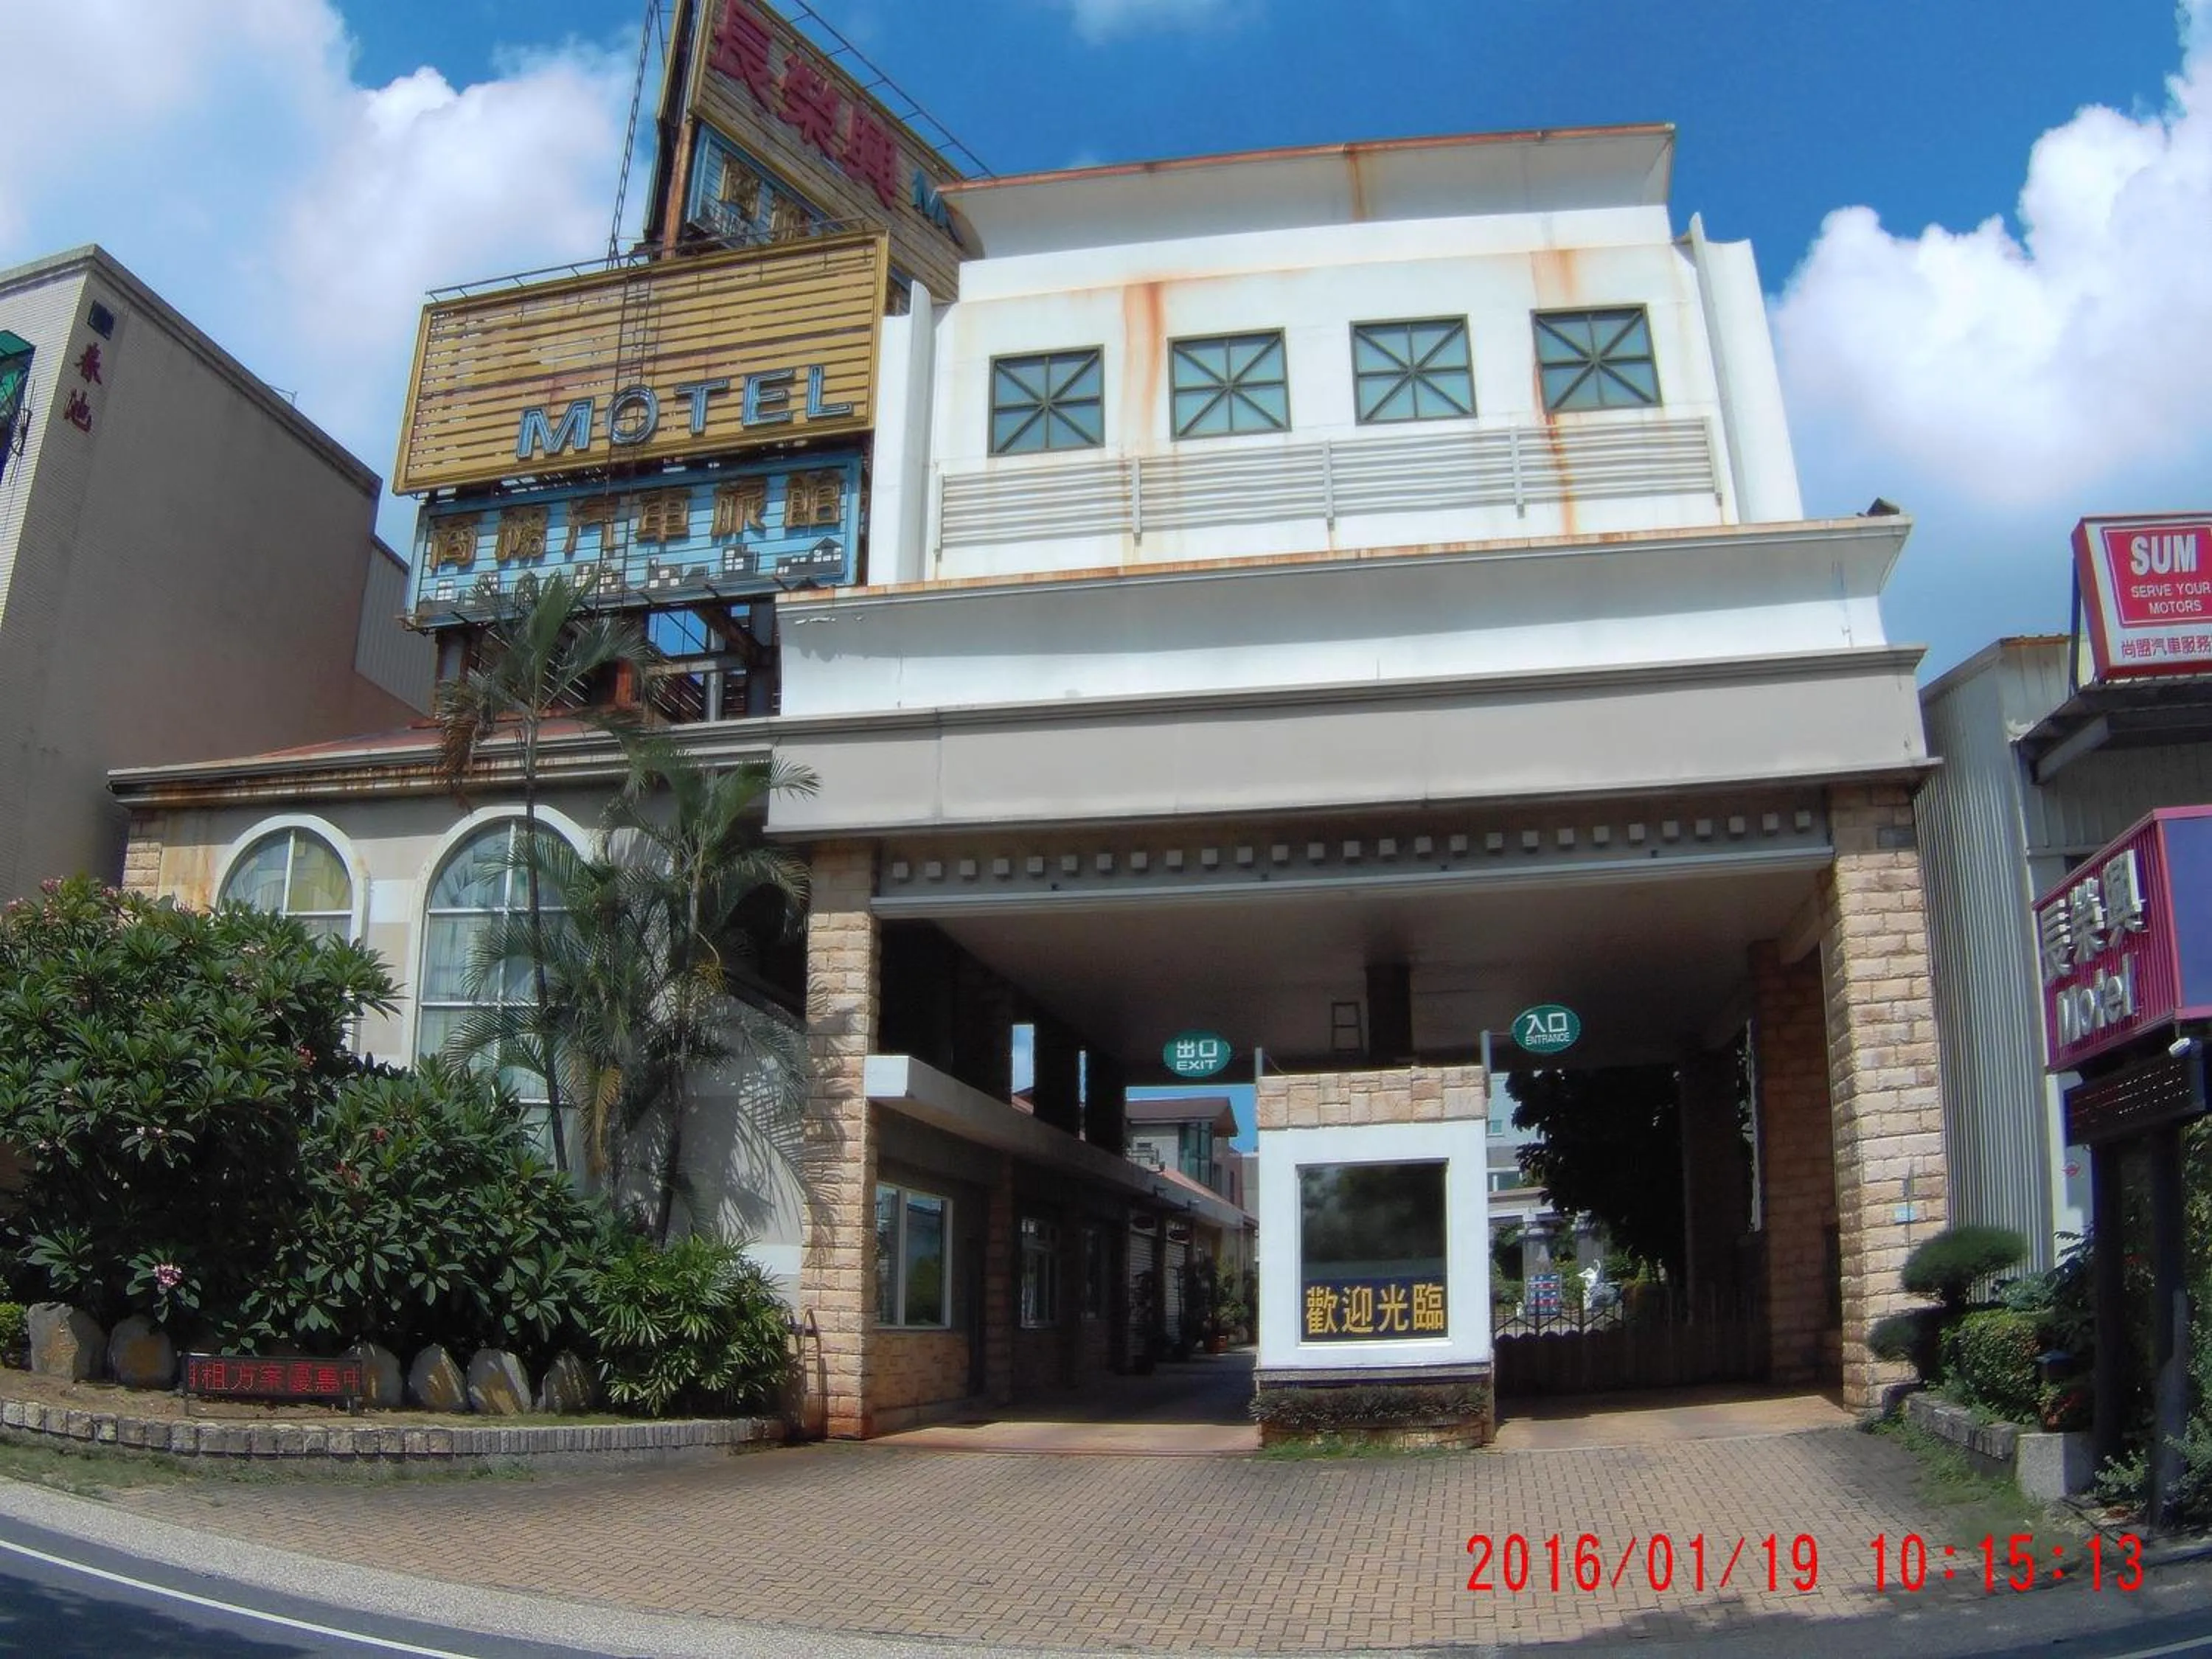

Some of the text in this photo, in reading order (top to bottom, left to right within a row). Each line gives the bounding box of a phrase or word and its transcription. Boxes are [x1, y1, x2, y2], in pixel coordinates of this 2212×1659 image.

[516, 365, 854, 460] MOTEL
[2130, 534, 2197, 576] SUM
[2130, 581, 2212, 598] SERVE YOUR
[2149, 599, 2202, 614] MOTORS
[1526, 1012, 1568, 1035] 入口
[1176, 1039, 1218, 1058] 出口
[1525, 1032, 1571, 1046] ENTRANCE
[1176, 1060, 1218, 1071] EXIT
[1307, 1282, 1444, 1335] 歡迎光臨
